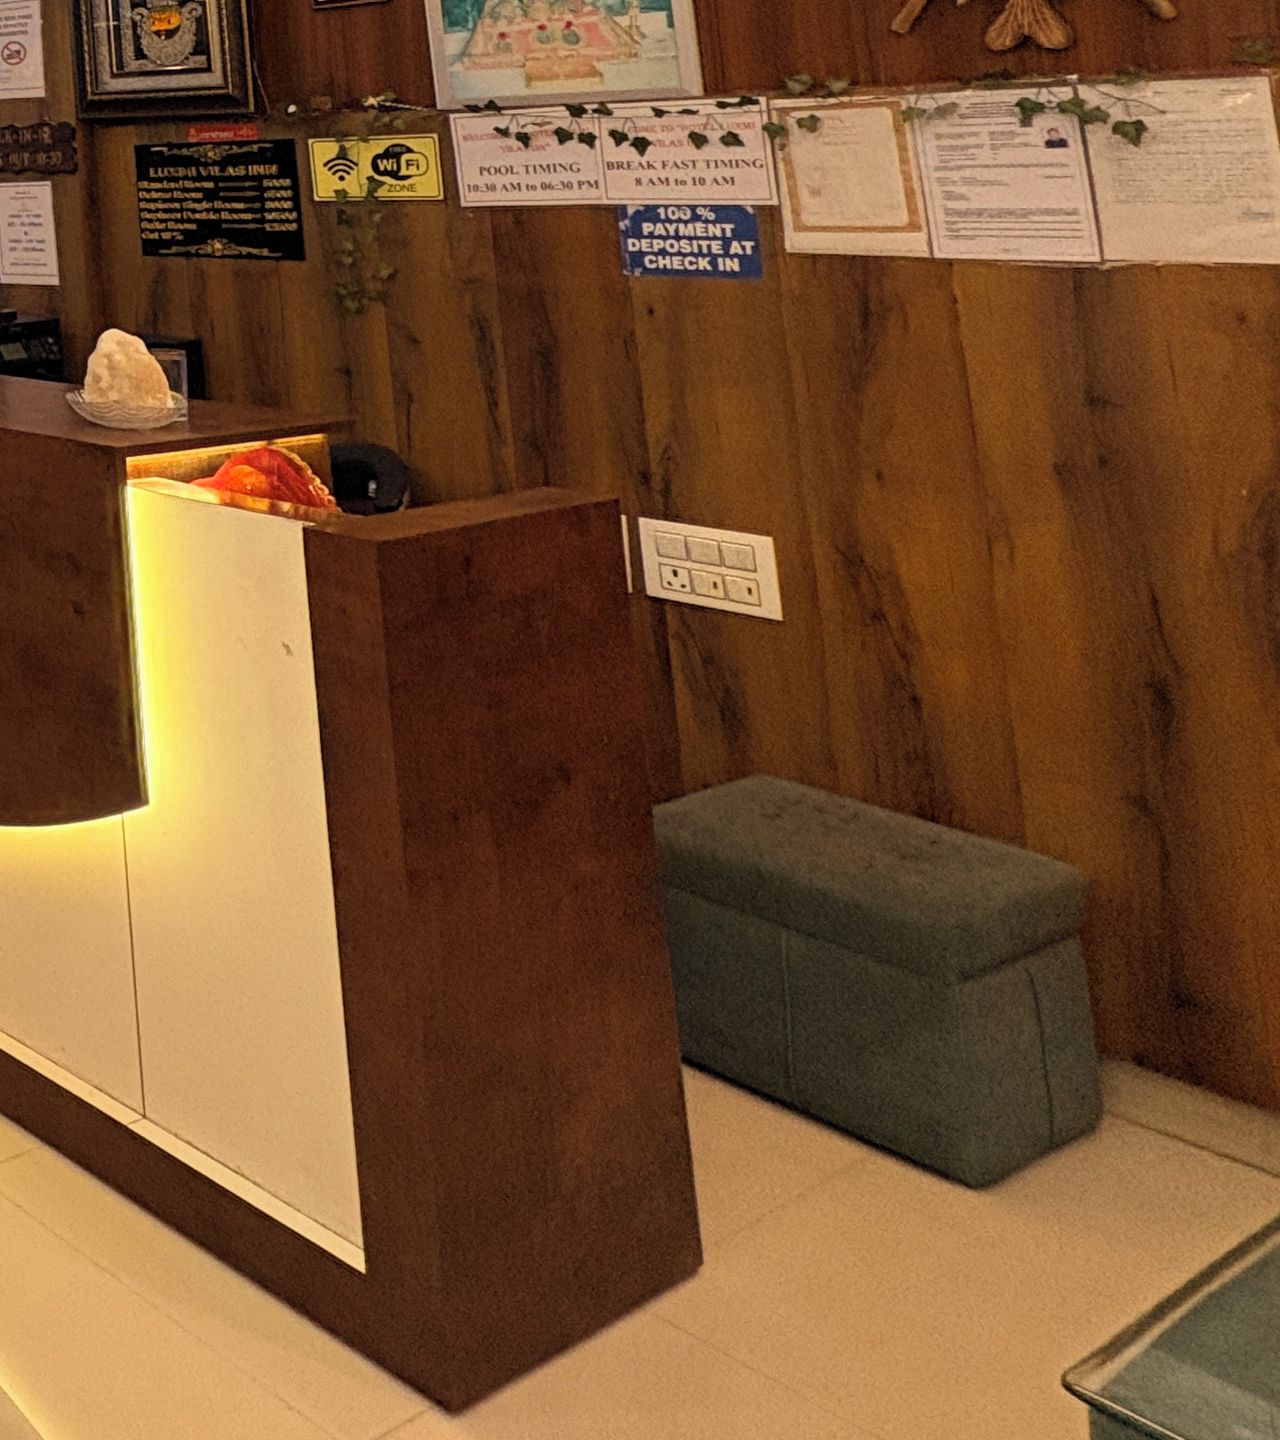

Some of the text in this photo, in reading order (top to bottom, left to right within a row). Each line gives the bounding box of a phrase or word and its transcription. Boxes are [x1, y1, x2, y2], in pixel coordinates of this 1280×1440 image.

[479, 161, 581, 177] POOL TIMING
[606, 158, 764, 171] BREAK FAST TIMING
[387, 183, 418, 193] ZONE
[466, 179, 600, 193] 10:30 AM to 06:30 PM
[634, 176, 736, 187] 8 AM to 10 AM
[657, 206, 716, 220] 100 %
[641, 221, 735, 237] PAYMENT
[627, 238, 755, 255] DEPOSITE AT
[643, 255, 740, 272] CHECK IN
